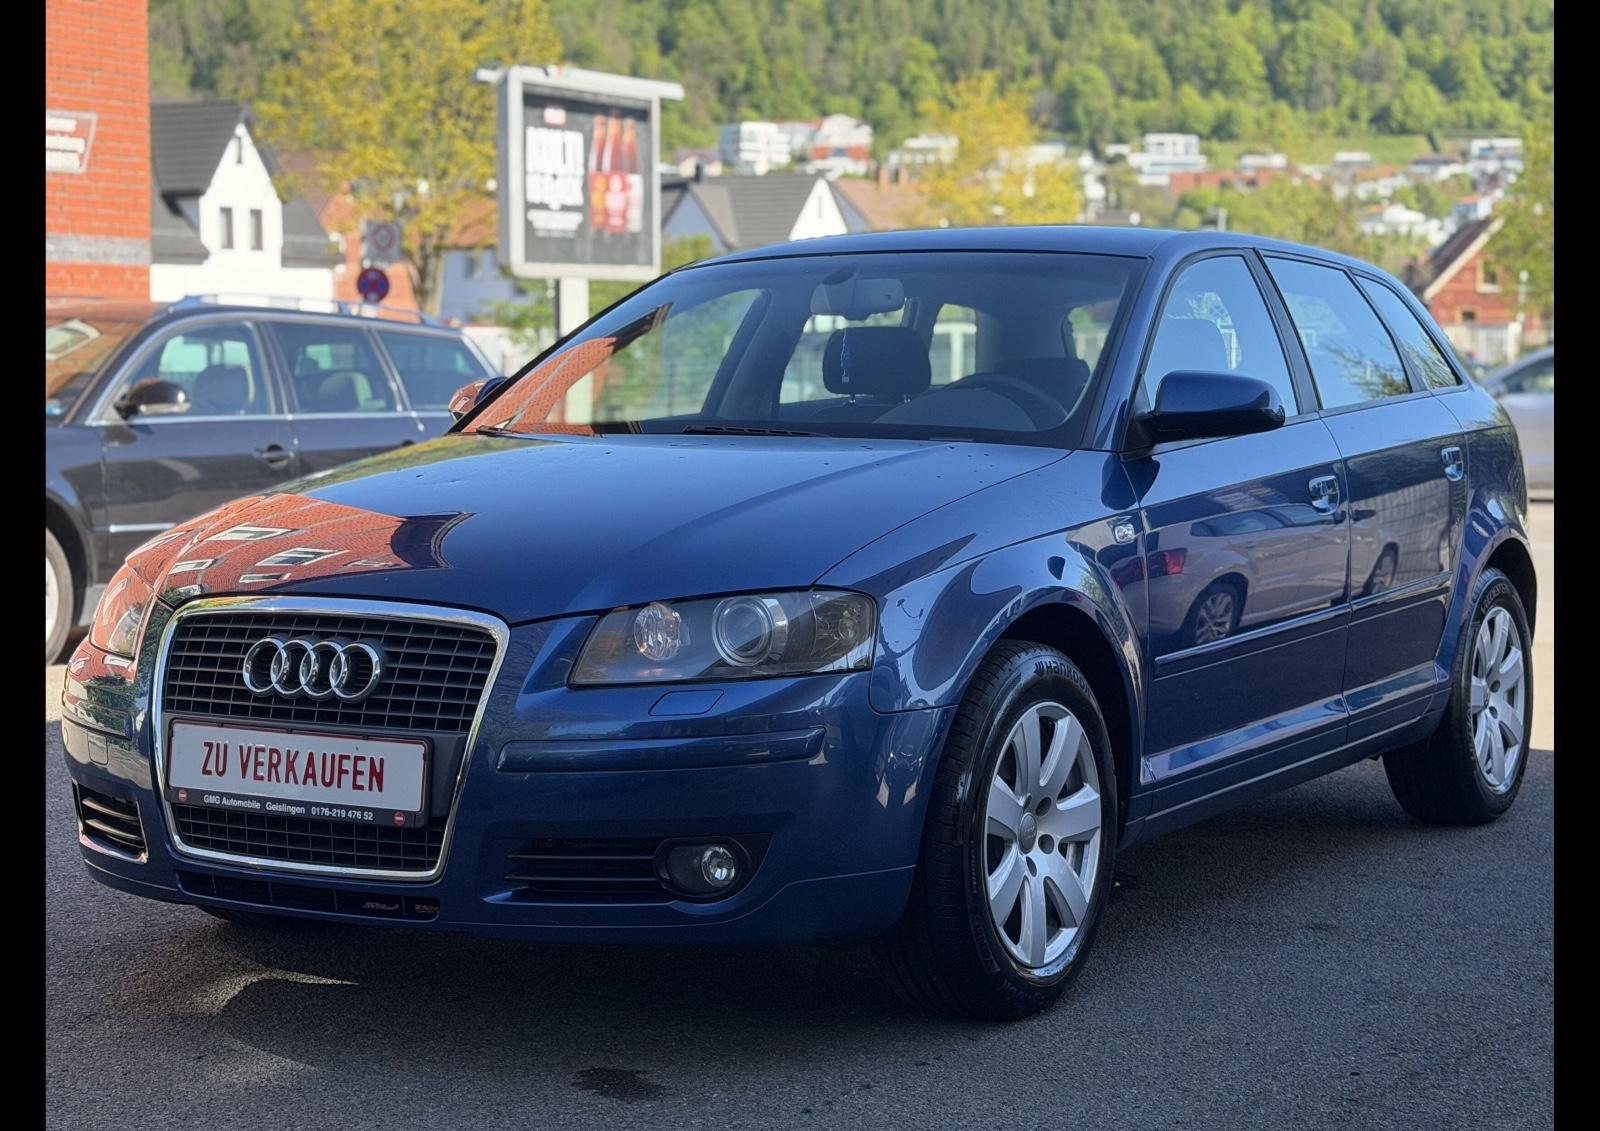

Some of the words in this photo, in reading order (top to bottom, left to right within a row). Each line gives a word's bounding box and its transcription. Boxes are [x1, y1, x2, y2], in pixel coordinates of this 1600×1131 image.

[202, 742, 228, 777] ZU
[239, 744, 385, 792] VERKAUFEN
[203, 795, 221, 804] GMG
[222, 796, 261, 809] Automobile
[265, 801, 305, 815] Geislingen
[311, 806, 346, 818] 0176-219
[347, 810, 362, 820] 476
[363, 811, 373, 821] 52
